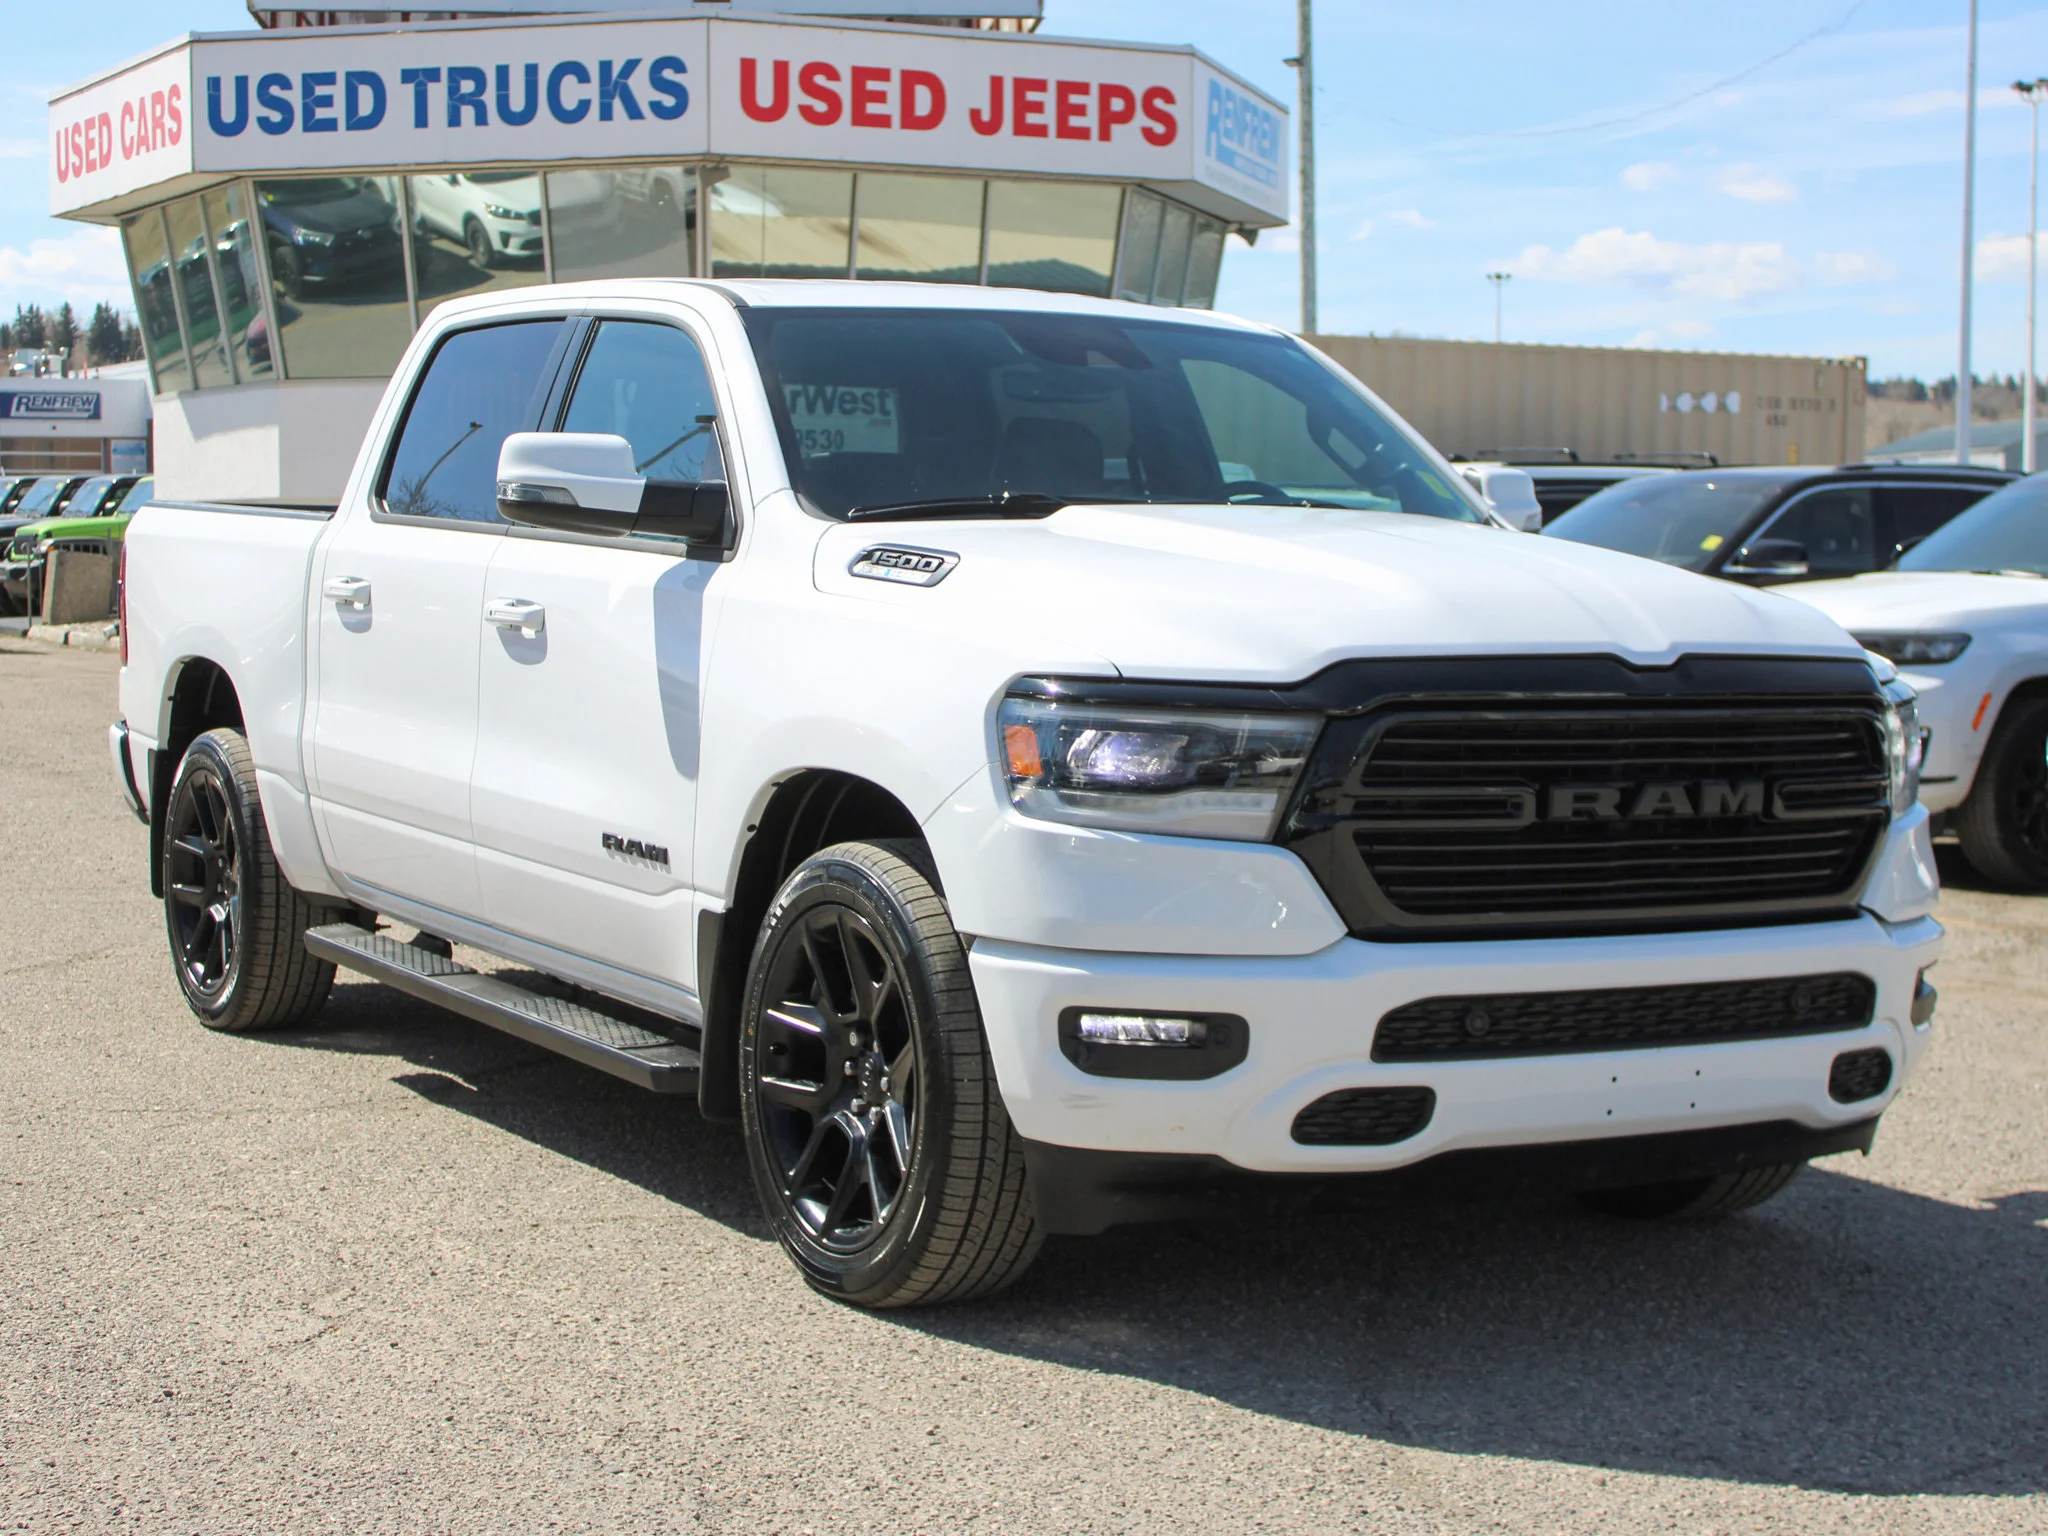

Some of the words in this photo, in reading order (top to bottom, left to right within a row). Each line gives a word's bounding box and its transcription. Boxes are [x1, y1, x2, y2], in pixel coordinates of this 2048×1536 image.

[206, 69, 387, 137] USED
[401, 55, 689, 129] TRUCKS
[739, 57, 947, 131] USED
[969, 75, 1178, 147] JEEPS
[1205, 77, 1280, 165] RENFREW
[57, 112, 112, 183] USED
[121, 84, 182, 160] CARS
[15, 394, 95, 412] RENFREW
[871, 550, 943, 572] 1500
[1551, 780, 1764, 820] RAM
[602, 830, 669, 866] RAM
